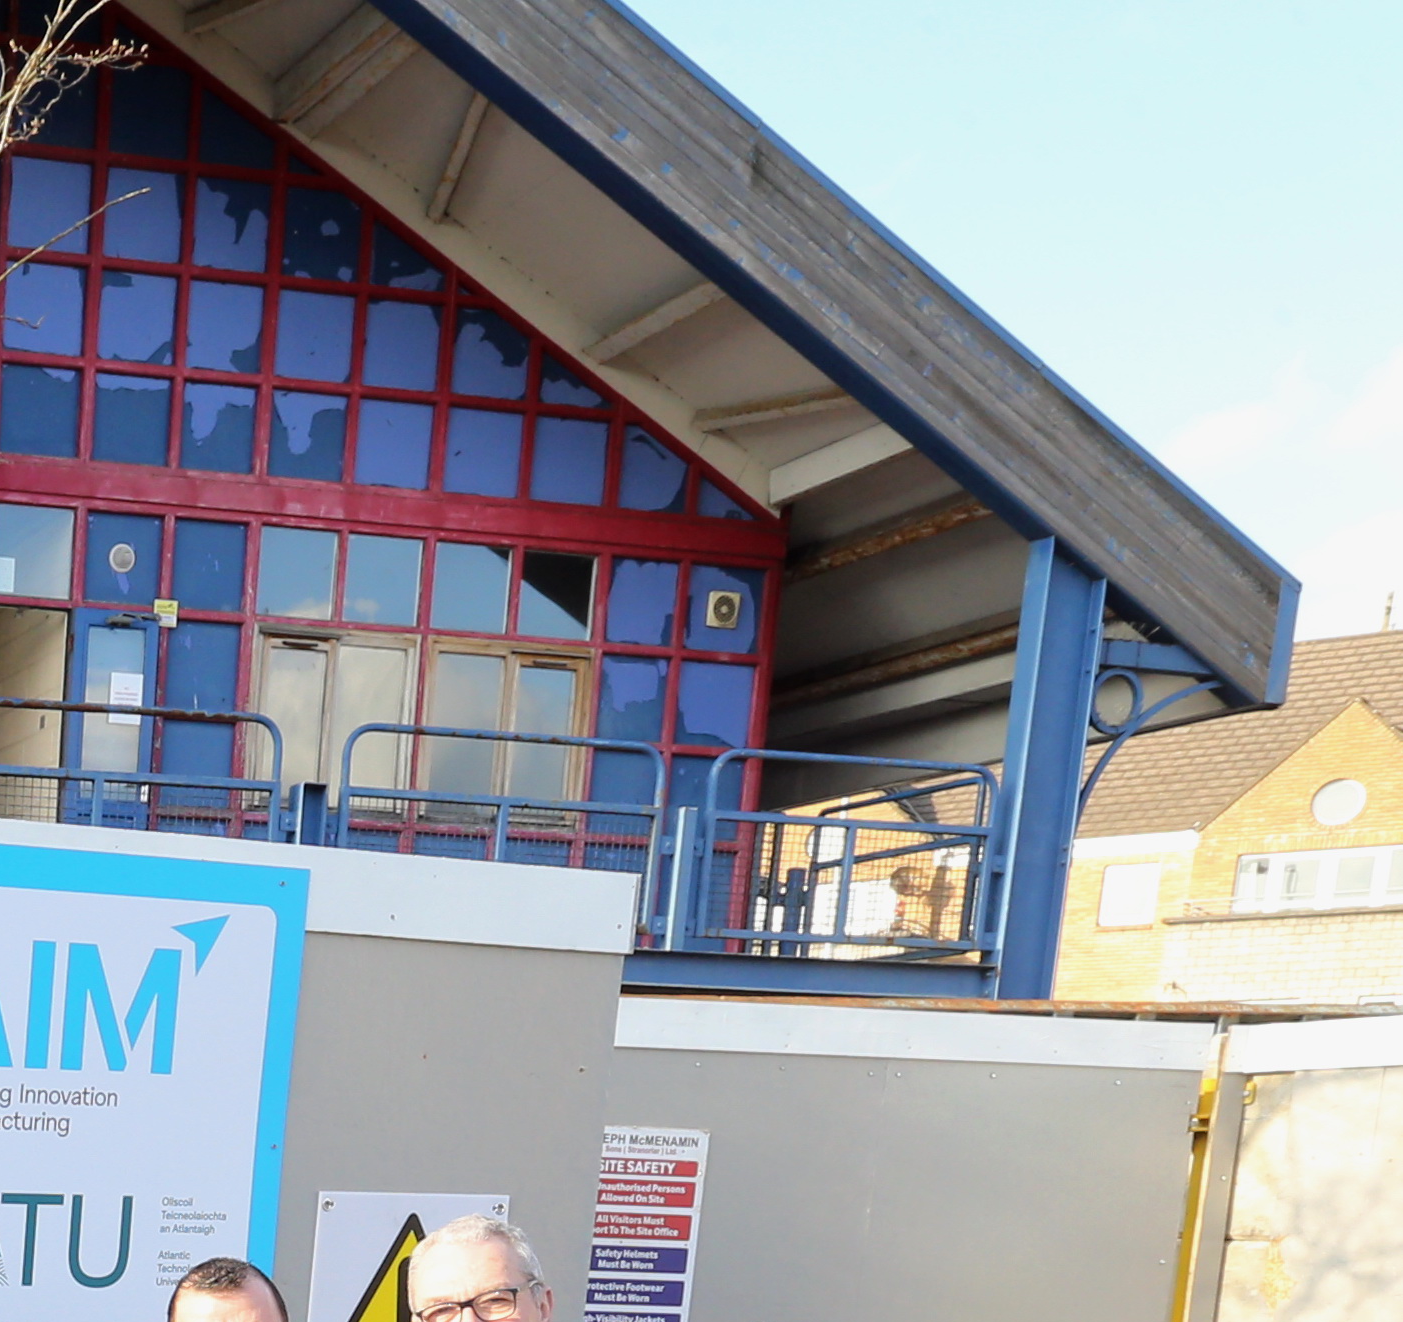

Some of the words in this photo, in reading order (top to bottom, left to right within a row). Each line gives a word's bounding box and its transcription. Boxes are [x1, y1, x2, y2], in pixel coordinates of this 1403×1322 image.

[19, 1083, 119, 1107] Innovation
[629, 1135, 699, 1148] McMENAMIN
[626, 1161, 675, 1174] SAFETY
[652, 1184, 686, 1195] Persons
[600, 1192, 634, 1203] Allowed
[635, 1194, 648, 1203] On
[649, 1195, 665, 1204] Site
[596, 1214, 609, 1223] All
[610, 1214, 642, 1225] Visitors
[643, 1216, 665, 1226] Must
[609, 1226, 619, 1235] To
[620, 1226, 635, 1236] The
[636, 1227, 653, 1236] Site
[654, 1228, 679, 1238] Office
[595, 1248, 623, 1260] Safety
[623, 1249, 659, 1260] Helmets
[598, 1258, 619, 1269] Must
[620, 1260, 631, 1269] Be
[632, 1260, 654, 1270] Worn
[626, 1282, 665, 1293] Footwear
[594, 1292, 616, 1302] Must
[617, 1293, 628, 1302] Be
[628, 1293, 650, 1303] Worn
